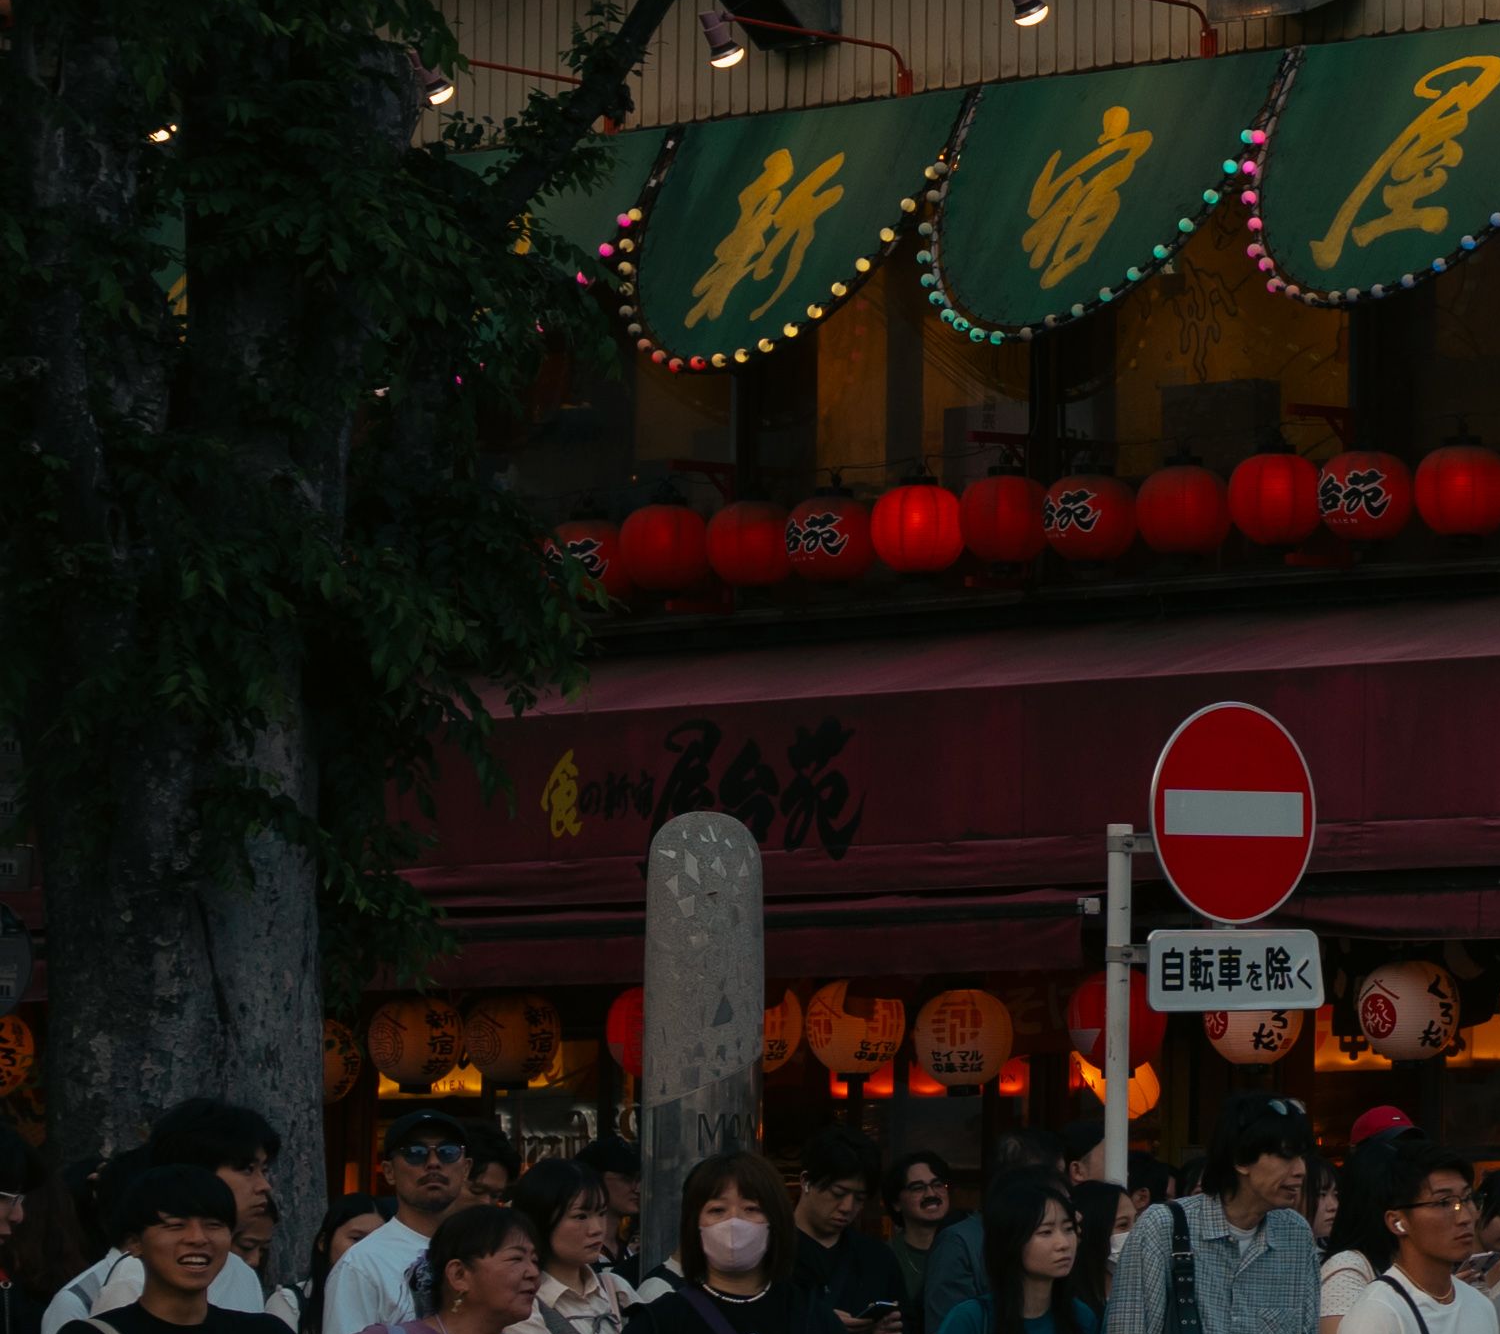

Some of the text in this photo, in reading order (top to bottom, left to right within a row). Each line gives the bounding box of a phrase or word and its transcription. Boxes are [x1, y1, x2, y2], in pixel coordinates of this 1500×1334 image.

[1020, 104, 1154, 291] 宿
[684, 147, 847, 331] 新
[1318, 467, 1394, 520] 台苑
[1162, 945, 1313, 993] 自転車を除く
[931, 1049, 984, 1063] セイマル
